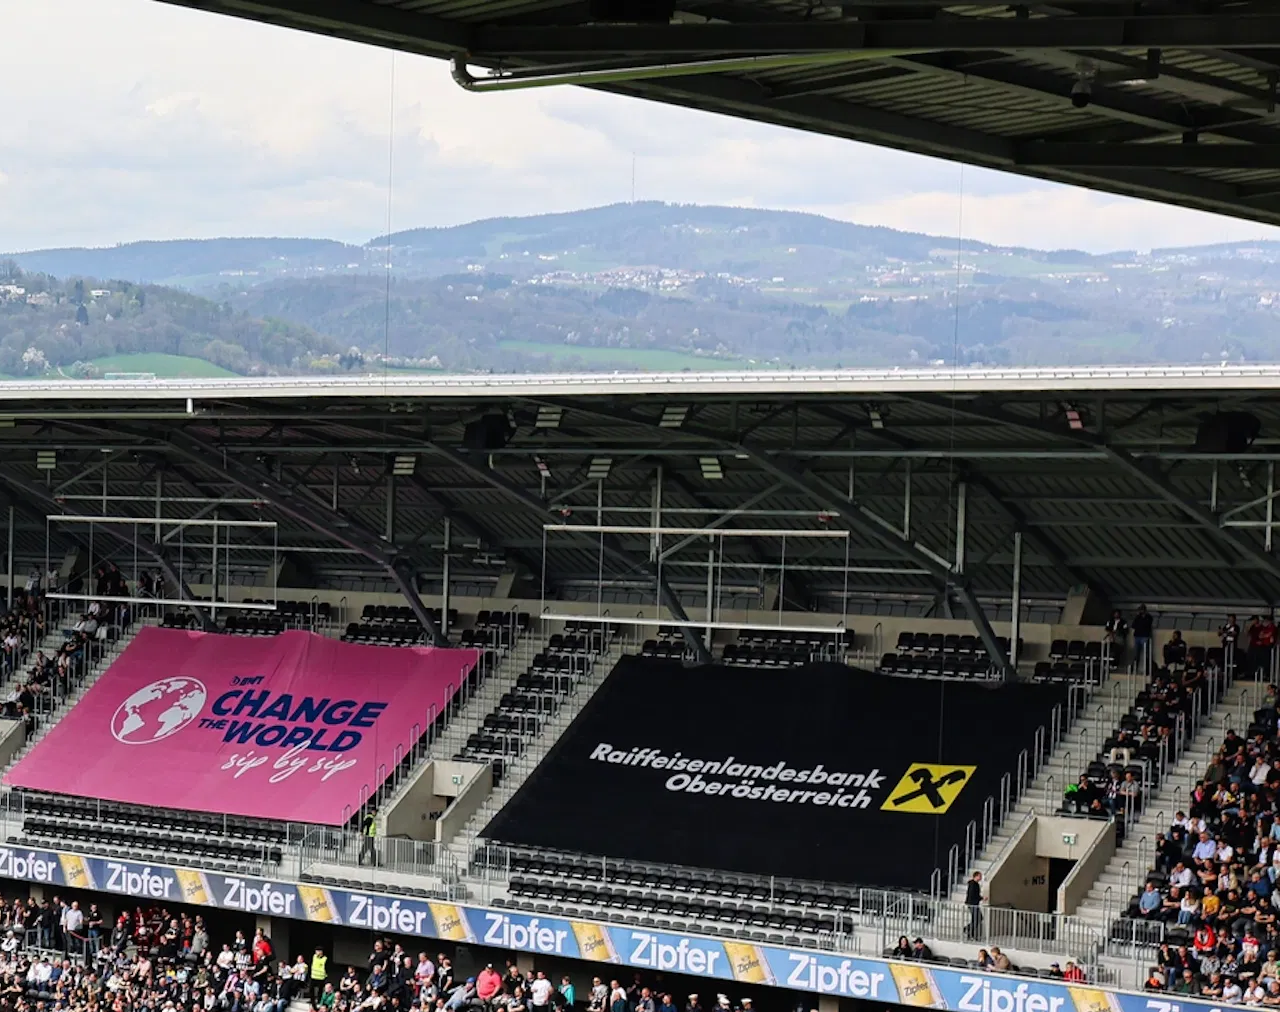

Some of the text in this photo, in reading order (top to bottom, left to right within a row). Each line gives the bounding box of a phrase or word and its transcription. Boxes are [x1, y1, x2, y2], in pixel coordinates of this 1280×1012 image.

[212, 689, 388, 727] CHANGE
[198, 719, 362, 752] THE WORLD
[221, 740, 357, 783] sip by sip
[589, 742, 887, 790] Raiffeisenlandesbank
[665, 774, 872, 810] Oberösterreich
[106, 863, 173, 897] Zipfer
[224, 878, 295, 914] Zipfer
[350, 895, 426, 933] Zipfer
[485, 912, 567, 952] Zipfer
[630, 932, 720, 975] Zipfer
[787, 953, 884, 998] Zipfer
